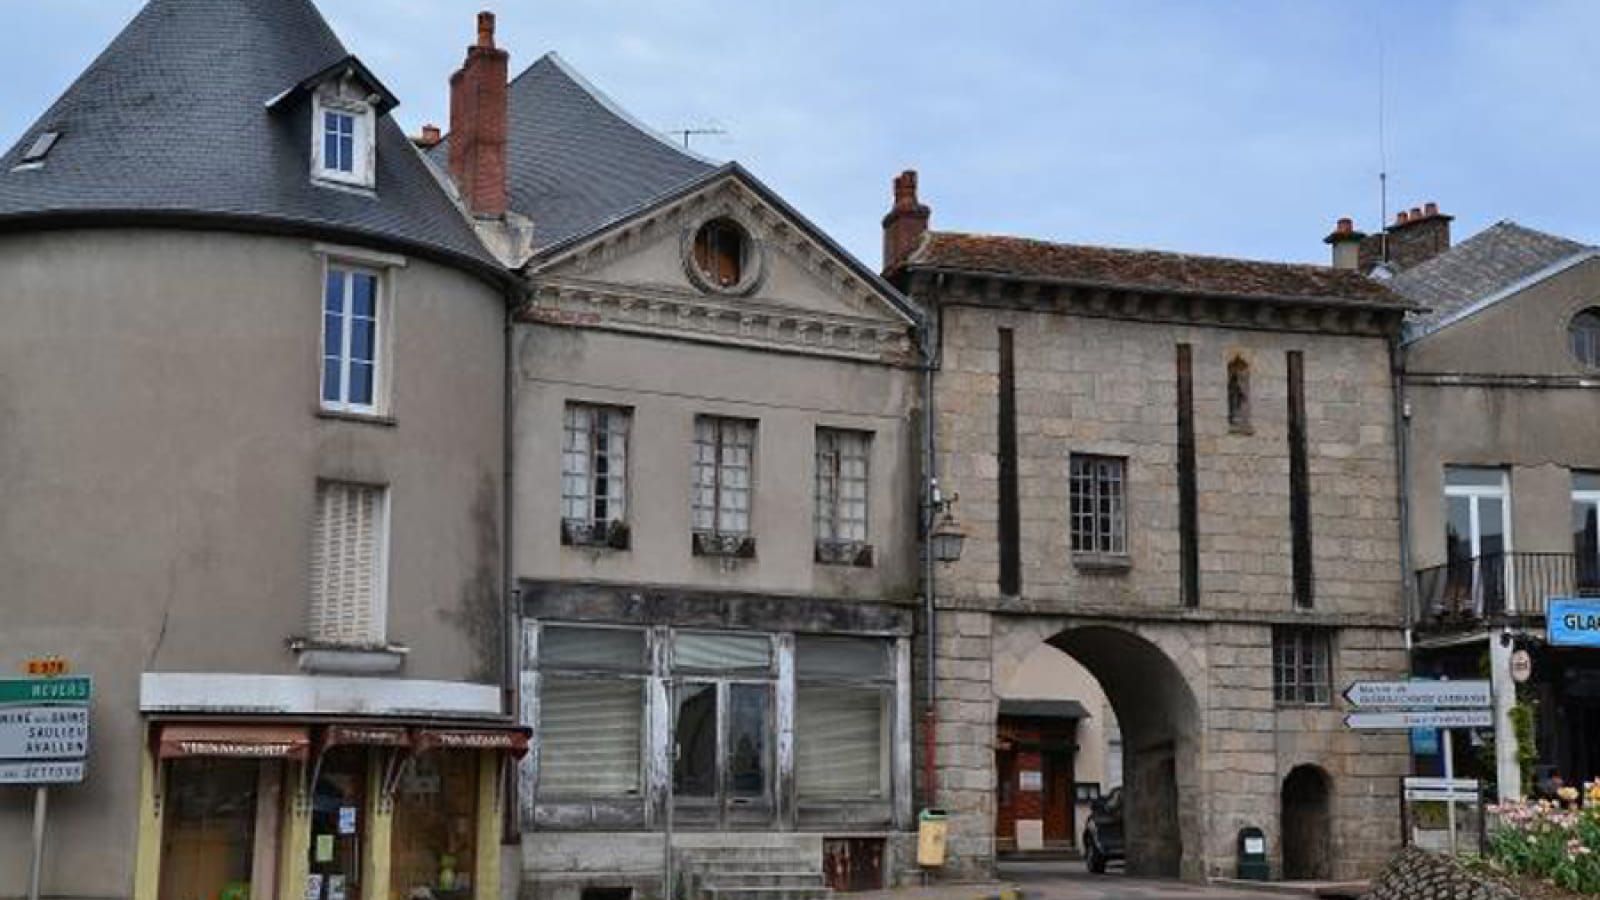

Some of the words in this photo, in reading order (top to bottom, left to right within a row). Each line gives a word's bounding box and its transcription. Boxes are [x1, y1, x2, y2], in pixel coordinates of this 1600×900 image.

[1564, 614, 1600, 631] GLA
[32, 684, 86, 697] NEVERS
[28, 727, 84, 738] SAULIEU
[25, 742, 84, 753] AVALLON
